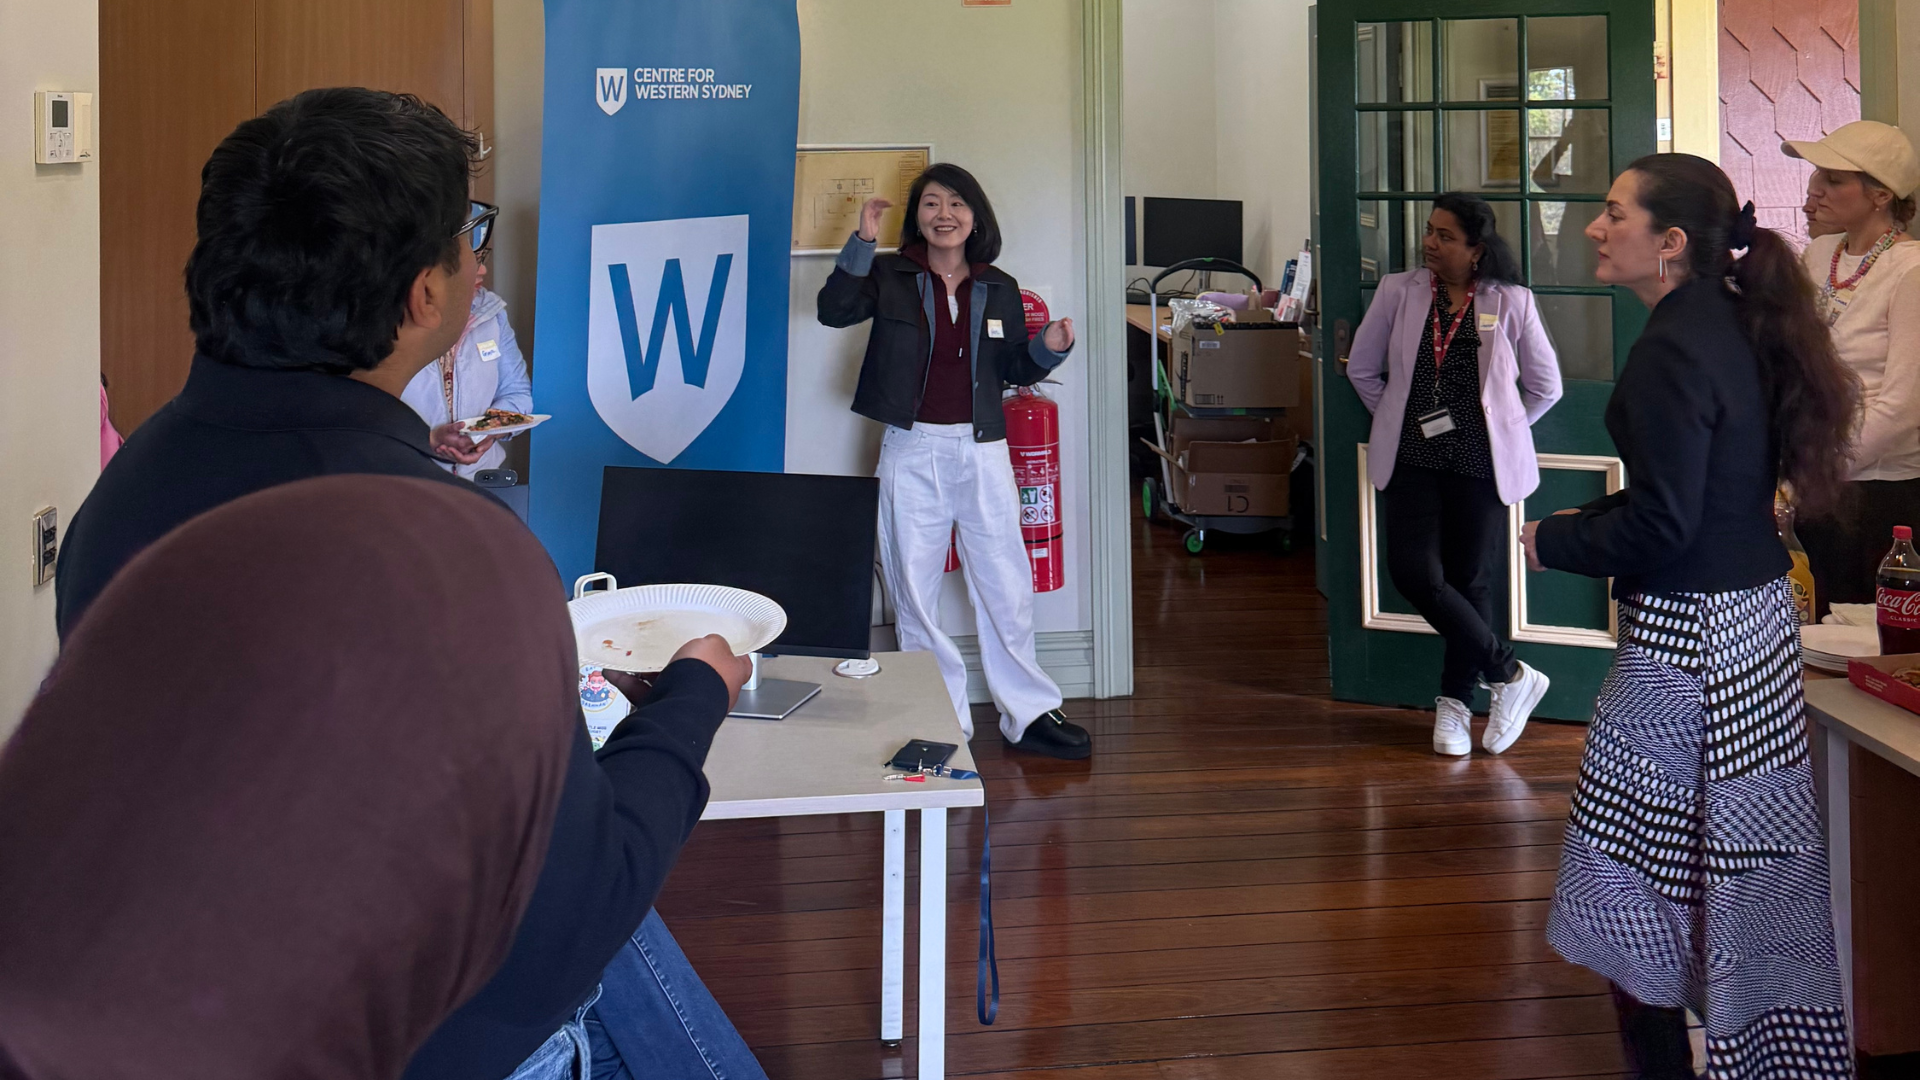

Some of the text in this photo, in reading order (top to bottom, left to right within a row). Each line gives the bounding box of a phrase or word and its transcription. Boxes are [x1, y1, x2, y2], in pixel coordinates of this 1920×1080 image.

[634, 67, 715, 83] CENTRE FOR
[600, 75, 624, 102] W
[635, 84, 752, 99] WESTERN SYDNEY
[1023, 303, 1034, 311] ER
[608, 253, 733, 402] W
[1876, 587, 1920, 615] Coca-Co
